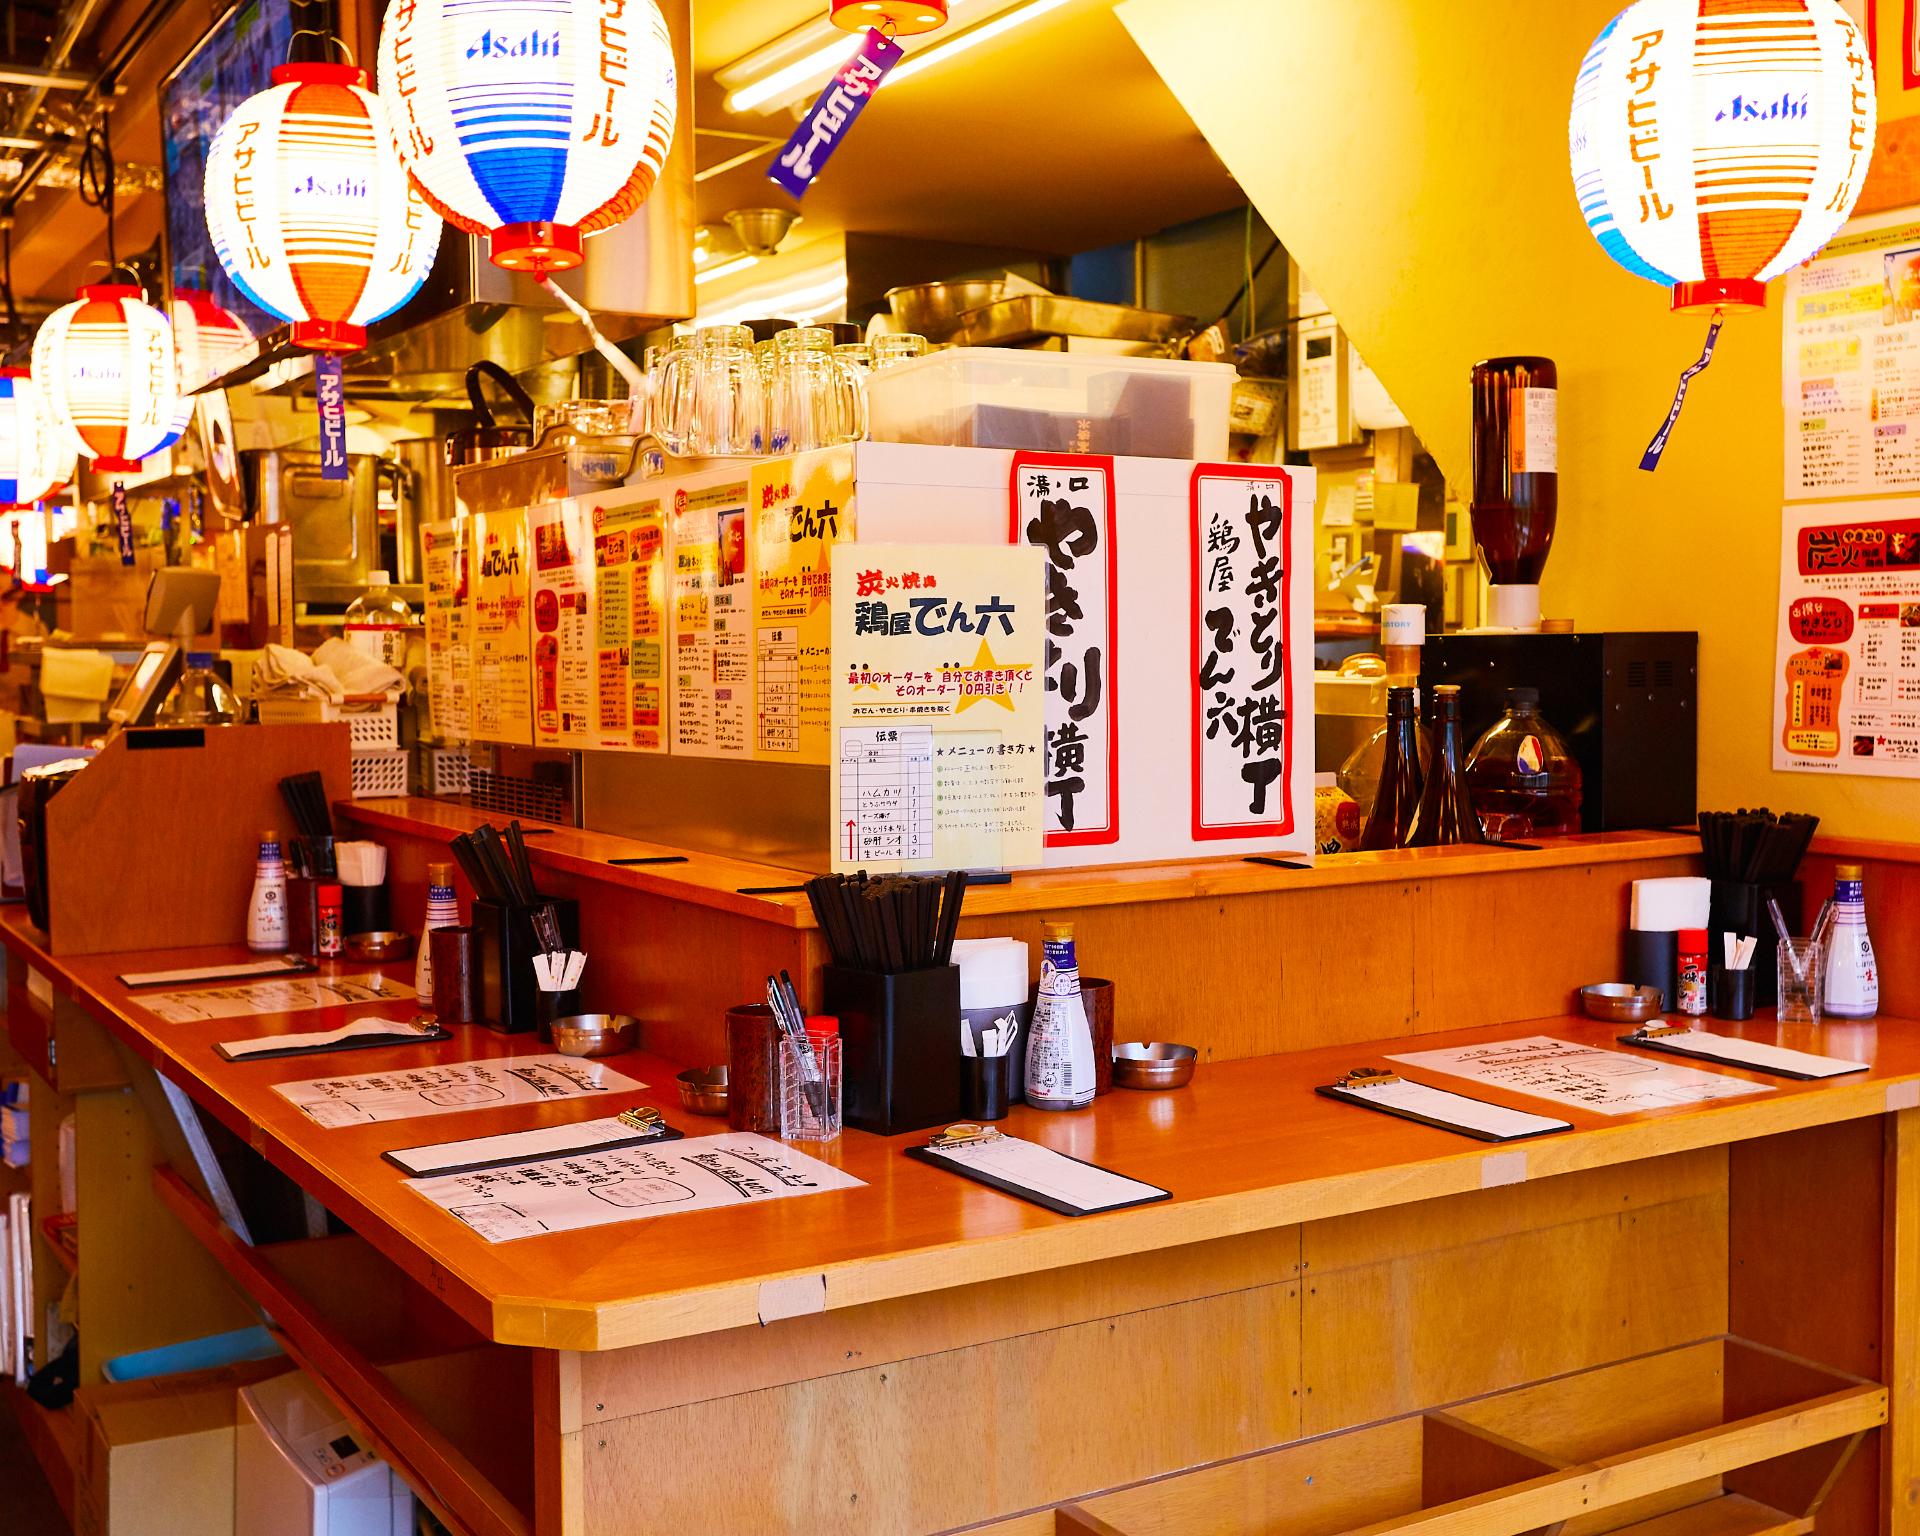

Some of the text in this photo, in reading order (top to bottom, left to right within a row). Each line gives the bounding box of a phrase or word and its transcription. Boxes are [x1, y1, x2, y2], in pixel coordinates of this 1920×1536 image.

[465, 28, 561, 60] Asahi
[781, 53, 884, 180] アサヒビール
[1714, 92, 1808, 123] Asahi
[1824, 18, 1868, 213] アサヒビール
[1625, 28, 1674, 224] アサヒビール
[232, 119, 271, 270] アサヒビール
[294, 175, 367, 198] Asahi
[318, 373, 344, 467] アサヒビール
[1844, 530, 1884, 543] やきとり
[855, 596, 1015, 636] 鶏屋でん六
[1236, 494, 1288, 815] やきとり横丁
[848, 670, 1033, 686] 最初のオーダーを 自分でお書き頂くと
[853, 706, 950, 715] おでん・やきとり・串焼きを除く
[876, 731, 898, 743] 伝票
[948, 743, 1026, 756] メニューの書き方
[862, 786, 916, 797] ハムカツ 1
[912, 798, 916, 808] 1
[913, 810, 916, 819] 1
[913, 823, 916, 832] 1
[863, 835, 918, 846] 砂肝 シオ 3
